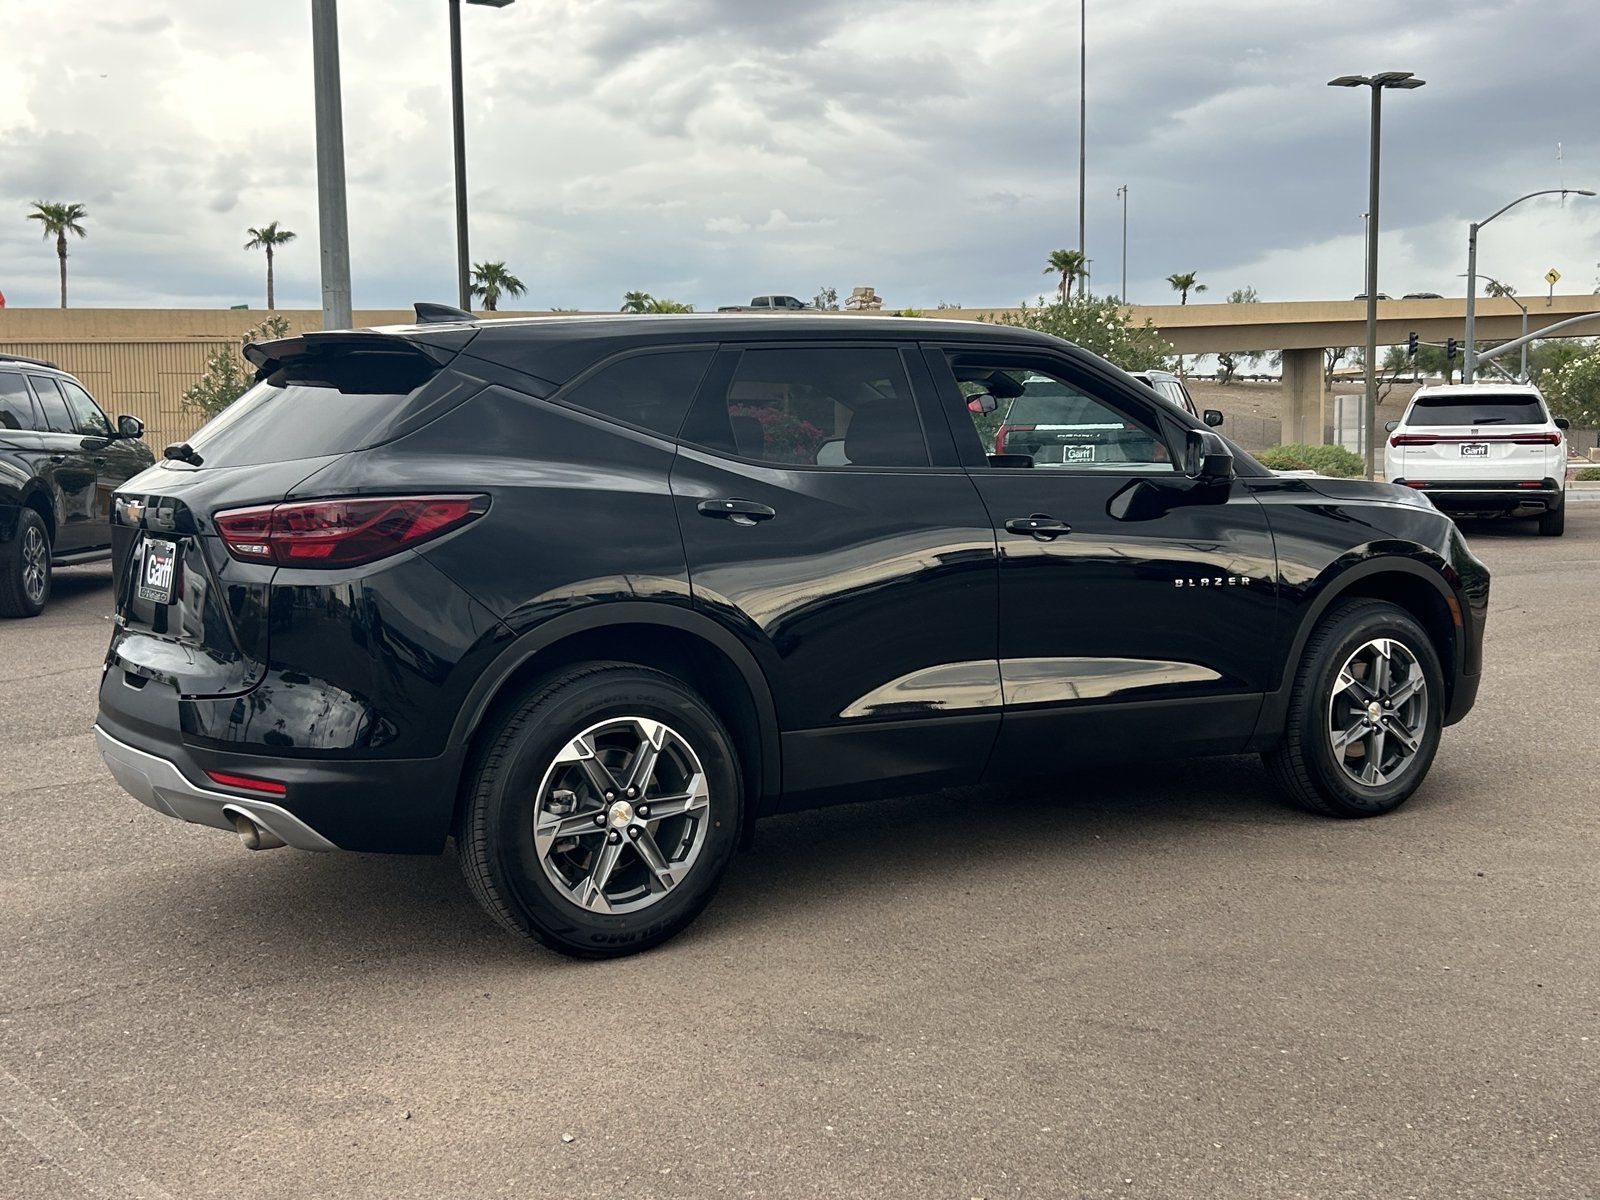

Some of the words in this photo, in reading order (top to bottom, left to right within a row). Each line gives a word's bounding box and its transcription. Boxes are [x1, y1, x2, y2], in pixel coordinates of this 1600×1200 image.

[1068, 449, 1090, 459] Garff
[1463, 446, 1485, 455] Garff
[148, 554, 173, 588] Garff
[1174, 576, 1250, 588] BLAZER
